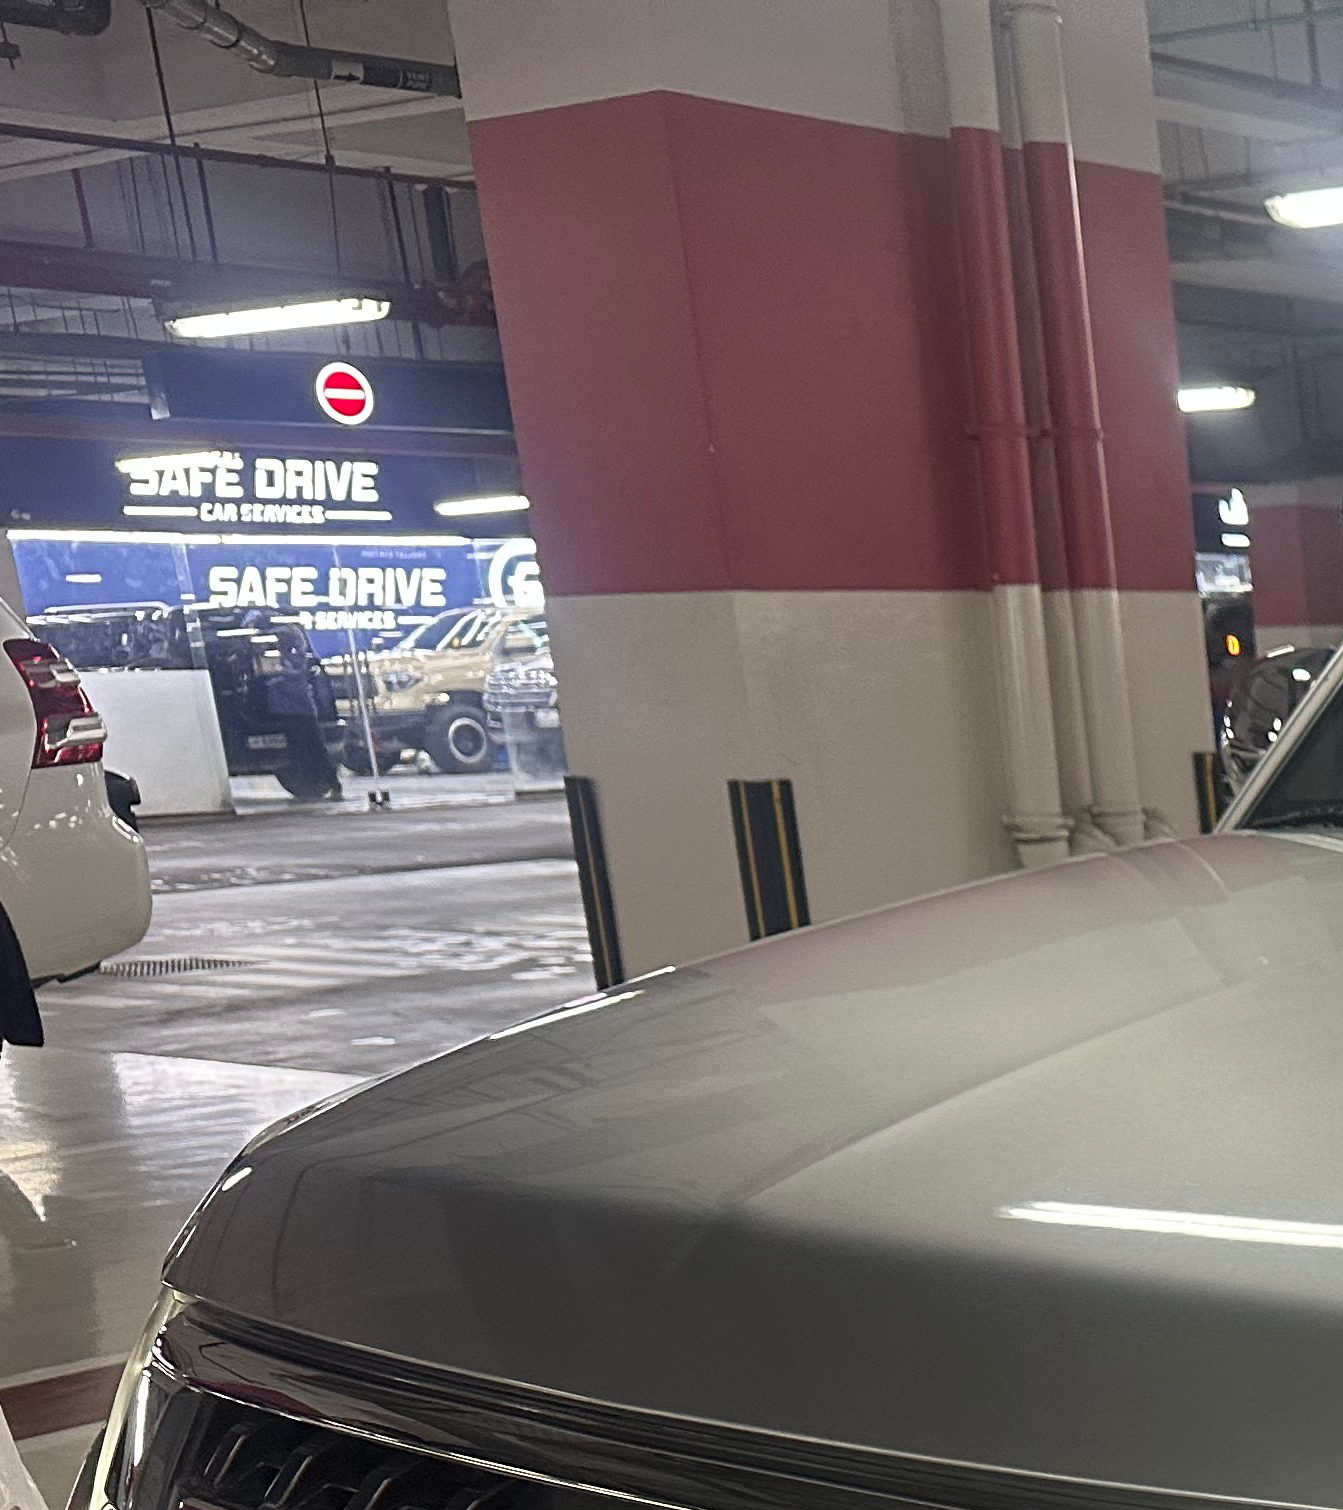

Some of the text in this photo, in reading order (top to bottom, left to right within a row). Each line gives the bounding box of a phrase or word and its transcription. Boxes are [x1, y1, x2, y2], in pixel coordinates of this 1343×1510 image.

[129, 455, 379, 502] SAFE DRIVE
[200, 502, 325, 524] CAR SERVICES
[209, 566, 318, 607] SAFE
[329, 567, 447, 607] DRIVE
[315, 611, 396, 630] SERVICES
